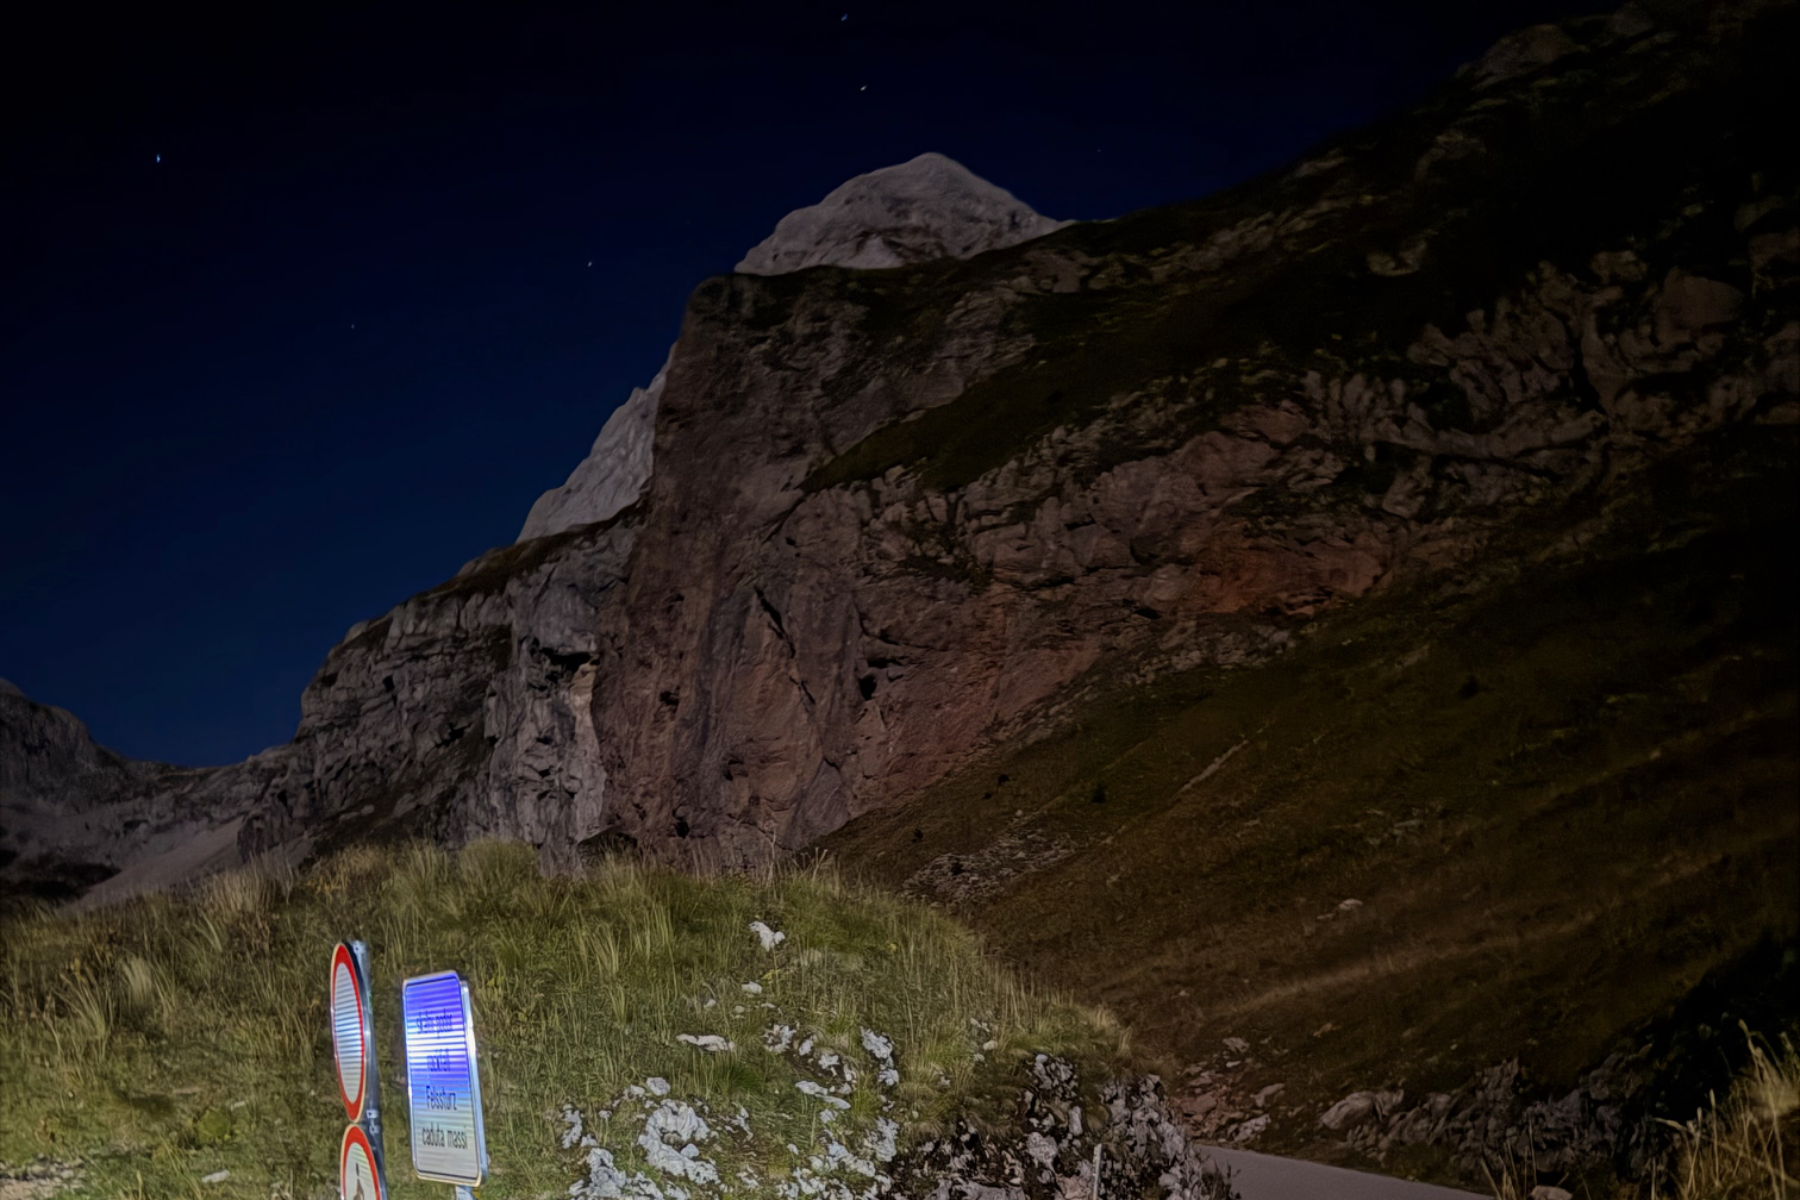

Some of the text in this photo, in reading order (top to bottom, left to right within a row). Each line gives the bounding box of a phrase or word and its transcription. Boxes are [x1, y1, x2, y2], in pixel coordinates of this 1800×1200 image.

[425, 1084, 457, 1111] Felssturz
[422, 1121, 469, 1150] caduta massi
